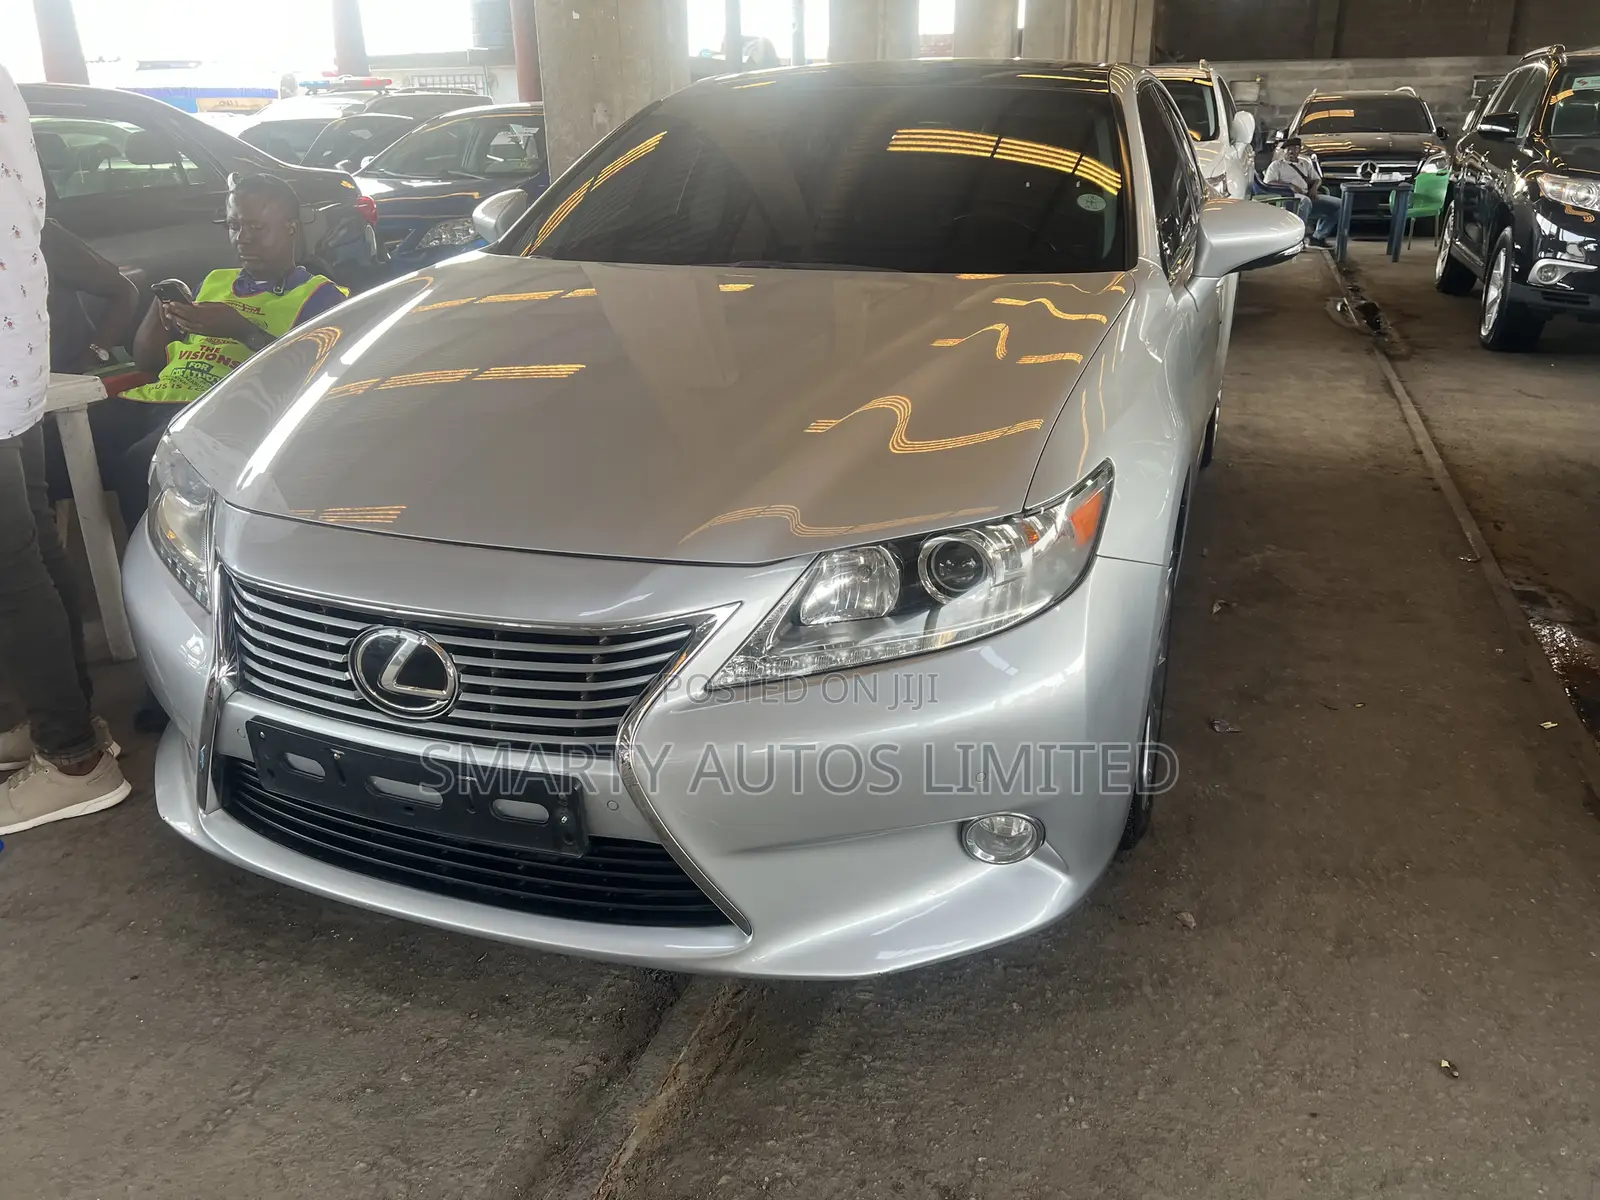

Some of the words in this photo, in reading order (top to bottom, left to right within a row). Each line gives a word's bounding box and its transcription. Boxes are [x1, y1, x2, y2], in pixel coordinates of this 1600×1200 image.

[200, 345, 221, 353] THE
[179, 350, 242, 369] VISIONS
[188, 361, 210, 372] FOR
